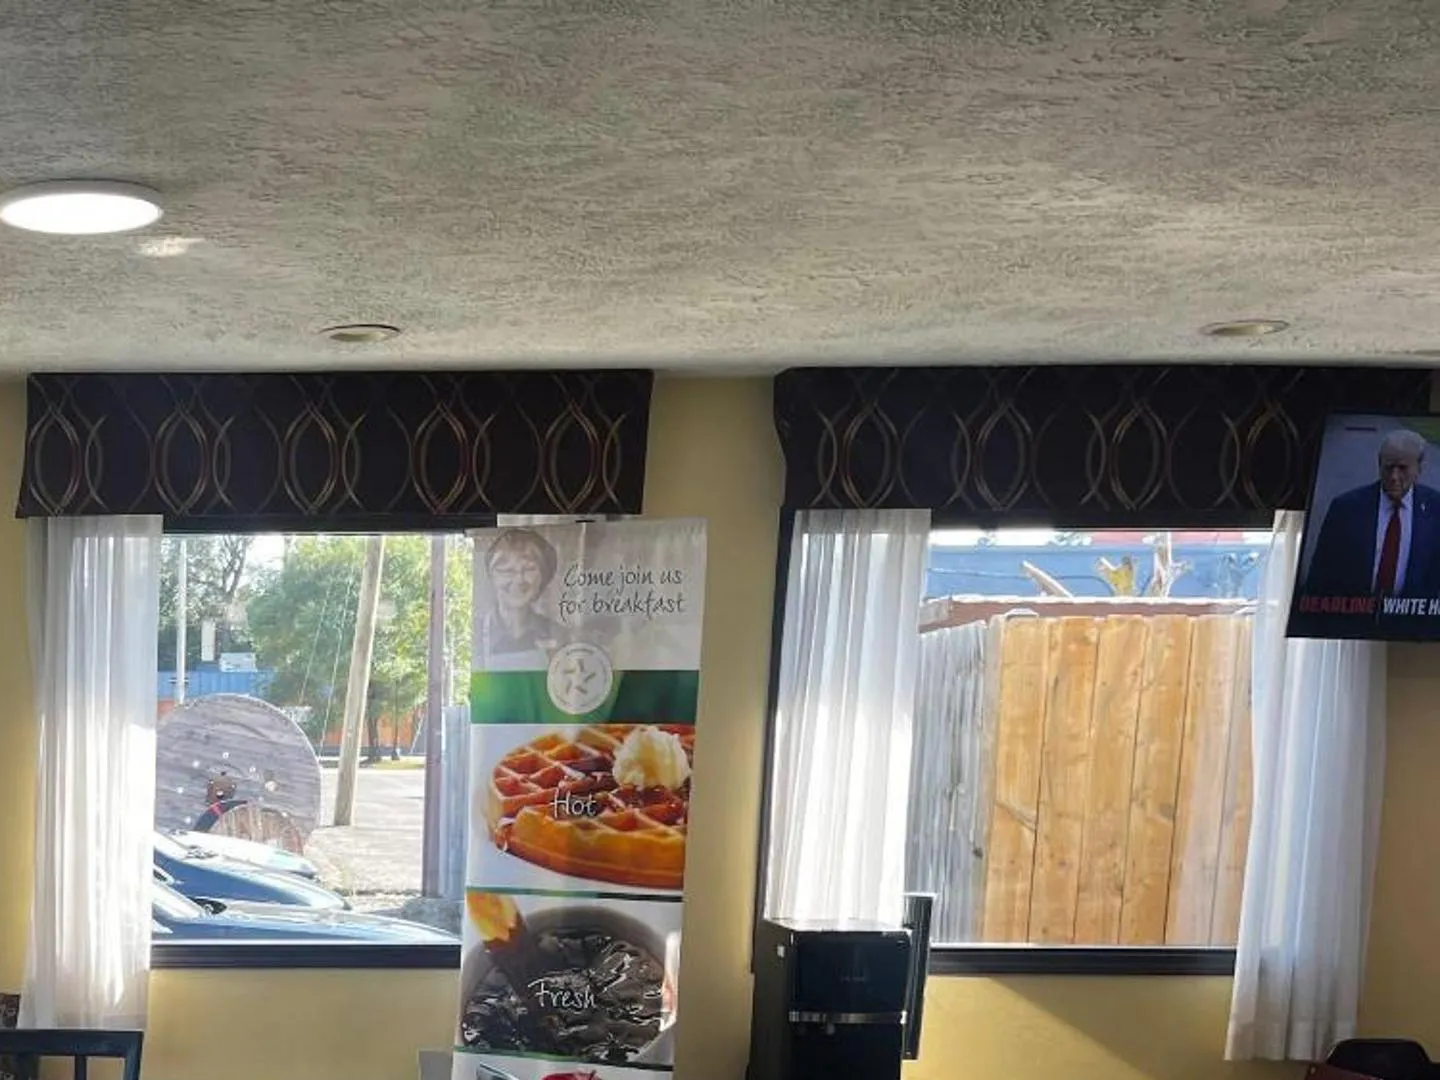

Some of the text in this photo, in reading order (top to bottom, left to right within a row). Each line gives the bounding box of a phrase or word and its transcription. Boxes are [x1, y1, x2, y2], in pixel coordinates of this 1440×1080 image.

[563, 562, 683, 593] Come join us
[558, 590, 686, 623] for breakfast
[1299, 596, 1440, 616] DEADLINE WHITE H
[549, 788, 598, 818] Hot
[527, 977, 597, 1009] Fresh
